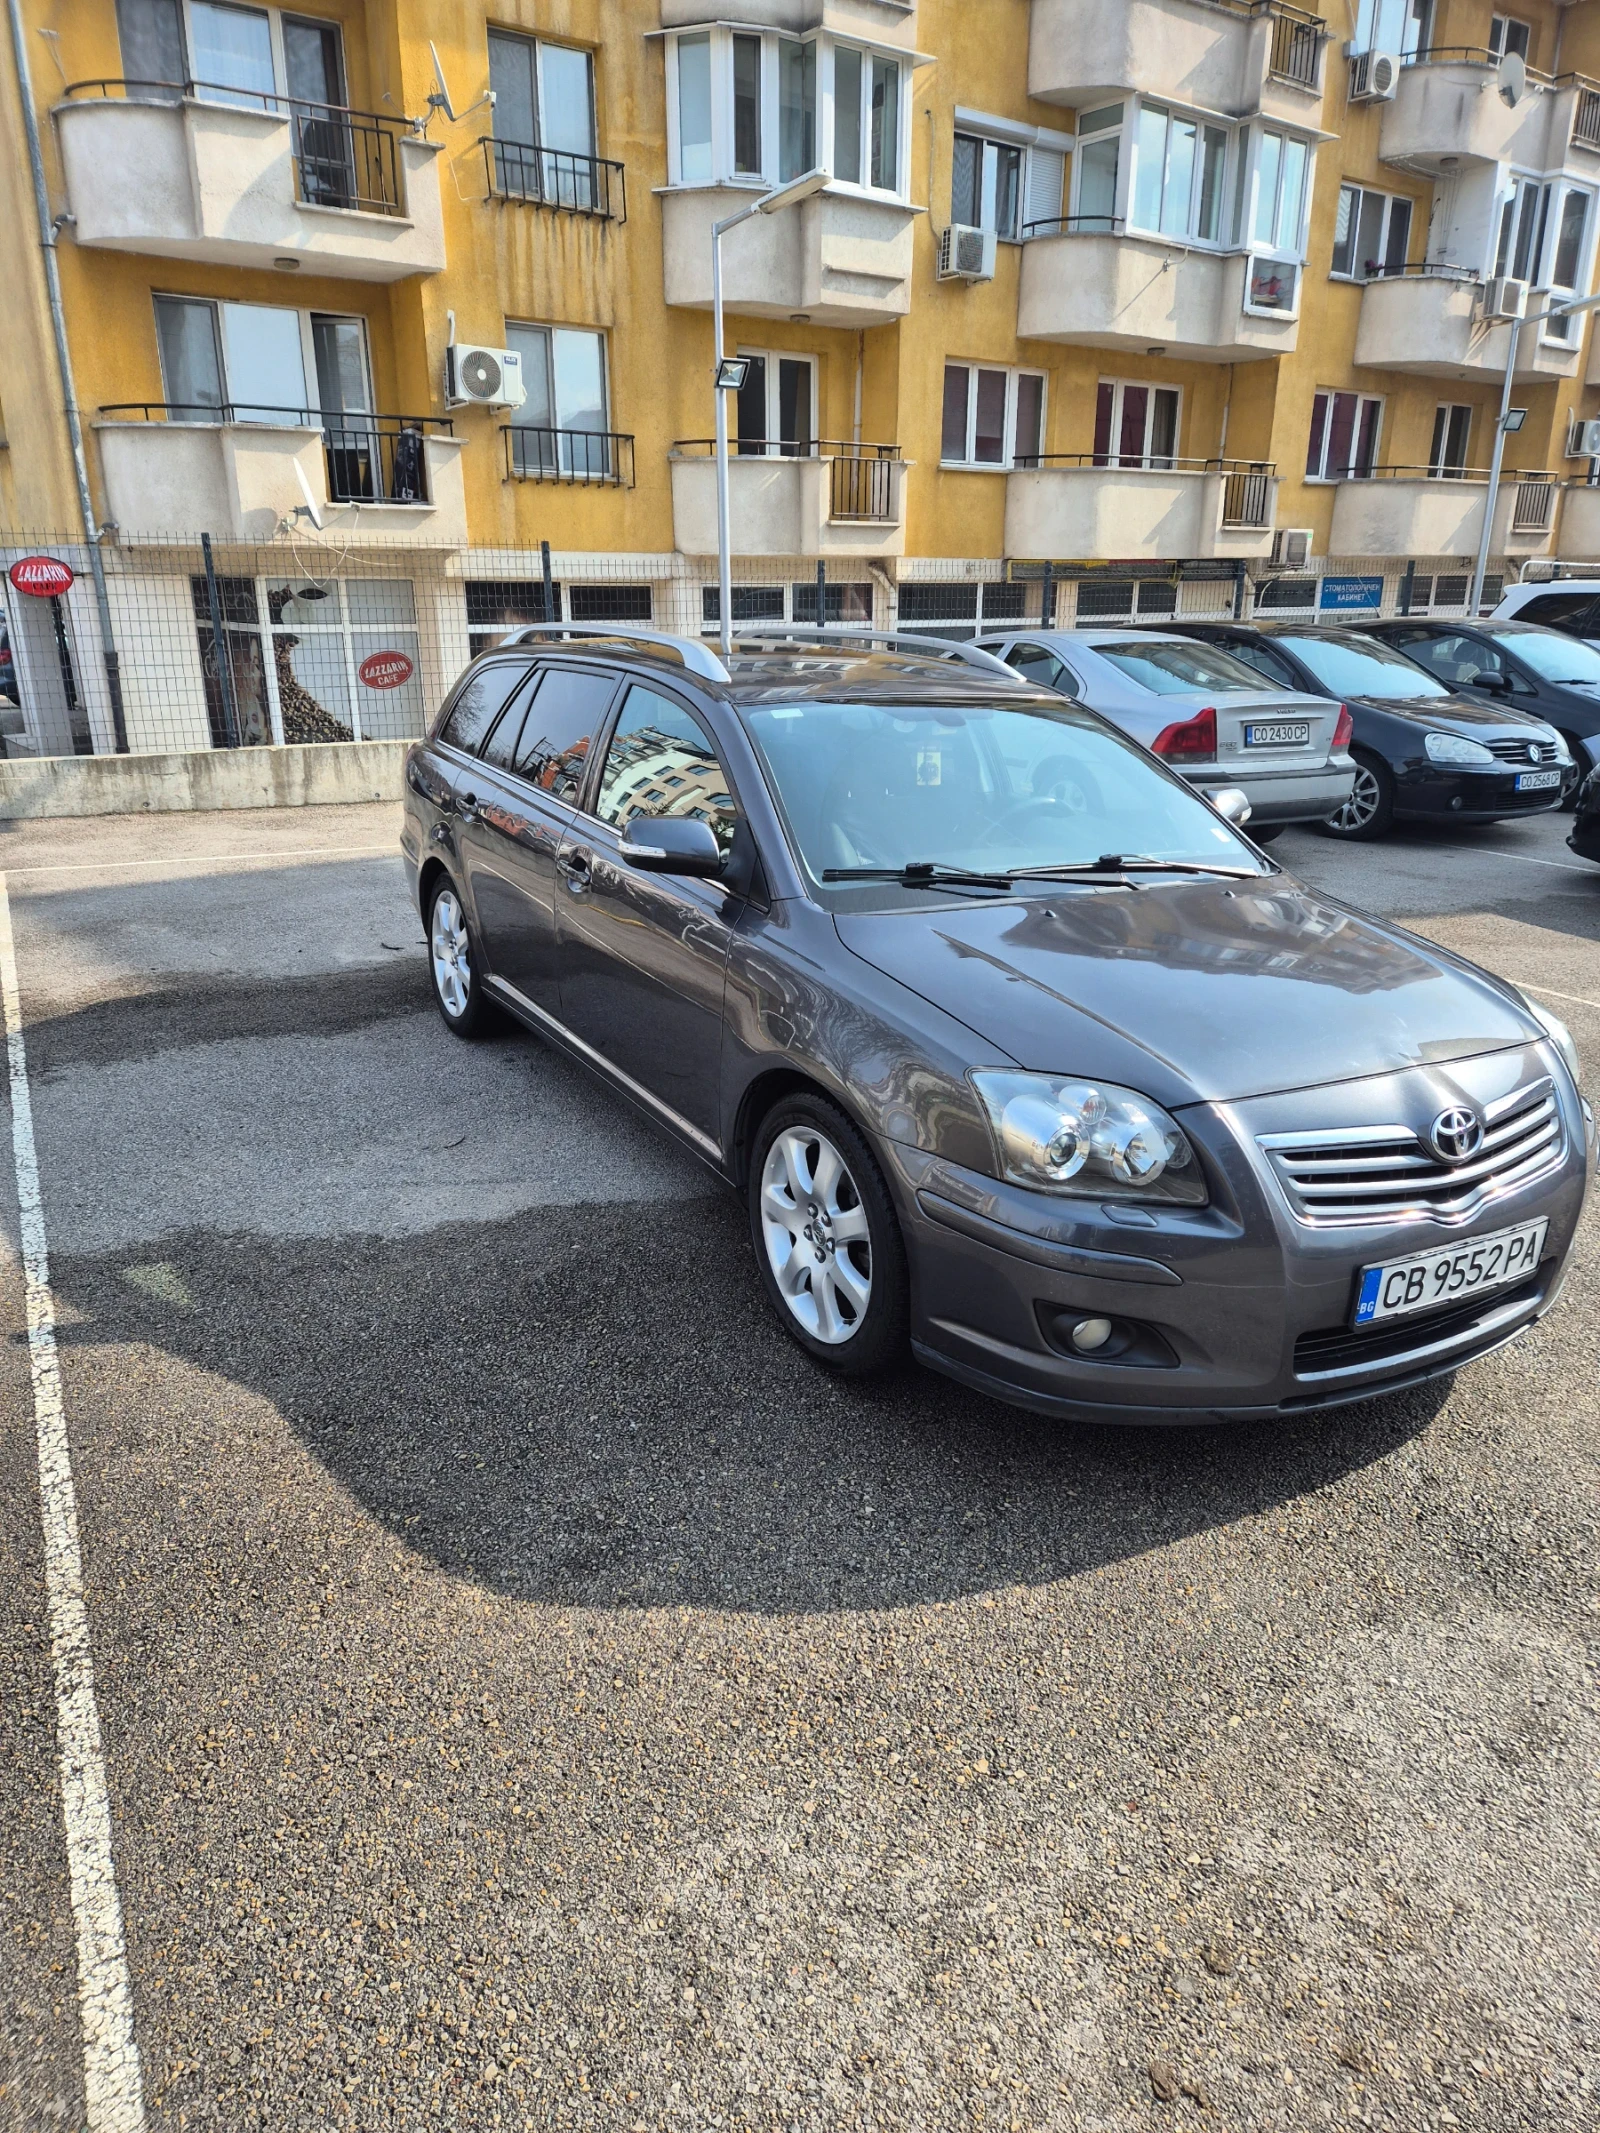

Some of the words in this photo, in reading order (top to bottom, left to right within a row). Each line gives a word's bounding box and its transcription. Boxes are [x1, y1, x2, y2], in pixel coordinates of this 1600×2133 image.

[1337, 593, 1366, 601] КАБИНЕТ
[377, 673, 399, 686] CAFE
[1254, 728, 1268, 741] CO
[1269, 726, 1293, 741] 2430
[1294, 725, 1307, 740] CP
[1521, 776, 1532, 788] CO
[1550, 772, 1560, 786] CP
[1383, 1266, 1427, 1309] CB
[1434, 1243, 1504, 1297] 9552
[1503, 1231, 1538, 1275] PA
[1359, 1300, 1375, 1315] BG
